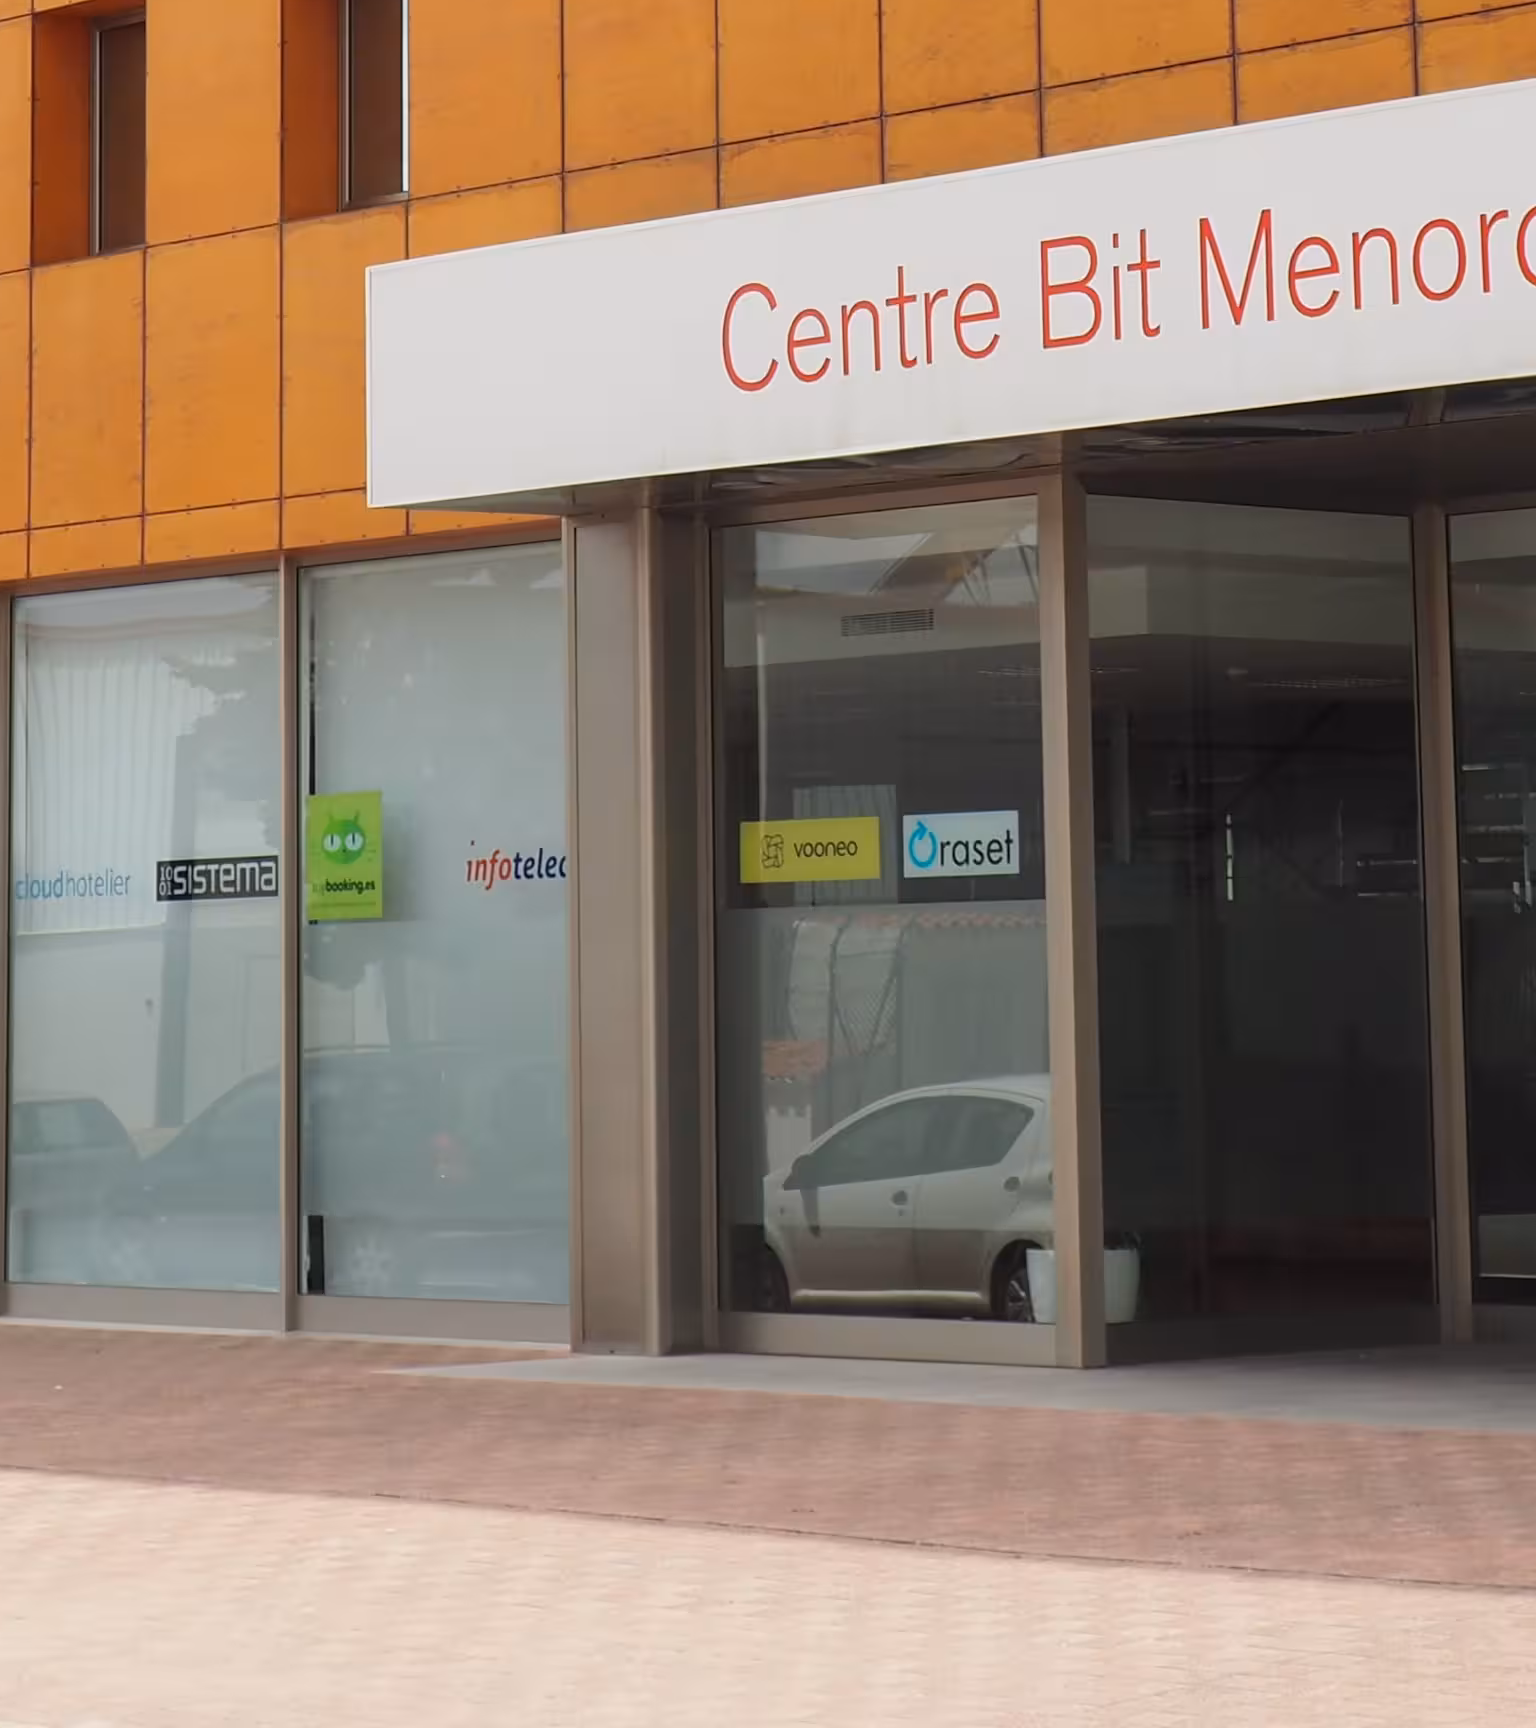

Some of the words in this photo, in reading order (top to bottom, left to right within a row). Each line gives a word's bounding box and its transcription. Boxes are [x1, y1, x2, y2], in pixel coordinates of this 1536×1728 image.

[721, 266, 1001, 392] Centre
[1040, 229, 1161, 350] Bit
[793, 840, 859, 859] vooneo
[15, 867, 131, 900] cloudhotelier
